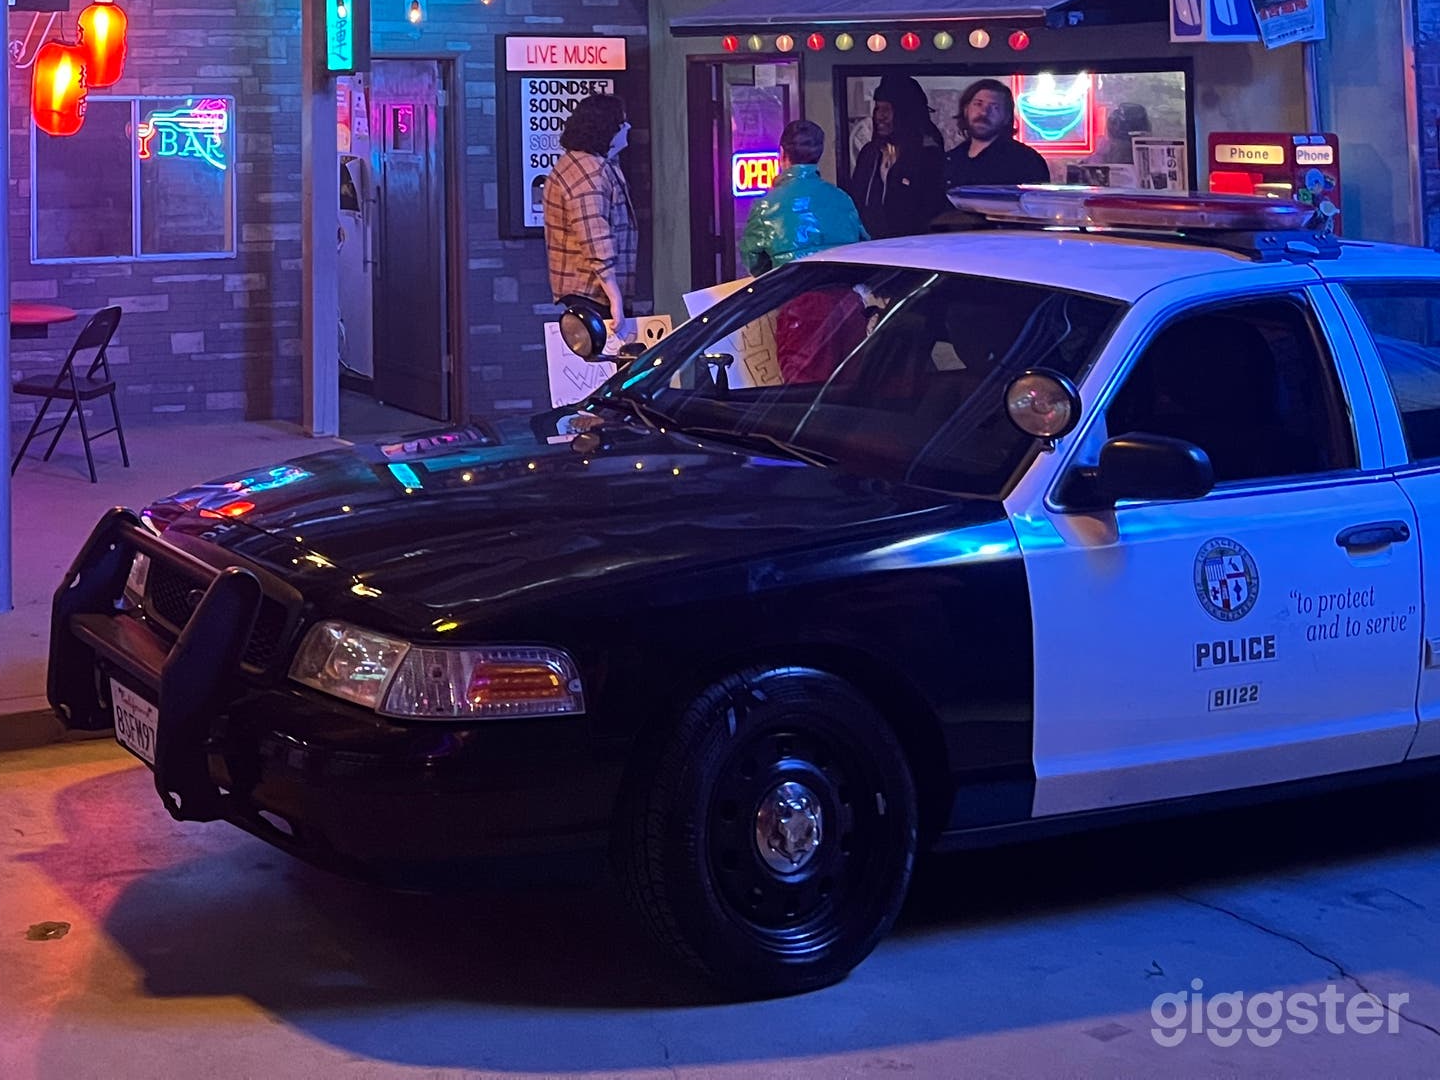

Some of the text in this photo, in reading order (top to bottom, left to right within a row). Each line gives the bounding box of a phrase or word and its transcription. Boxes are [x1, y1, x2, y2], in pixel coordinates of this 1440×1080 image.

[527, 45, 608, 64] LIVE MUSIC
[529, 80, 608, 95] SOUNDSET
[157, 127, 225, 158] BAR
[1230, 147, 1269, 160] Phone
[1297, 149, 1330, 162] Phone
[736, 159, 779, 190] OPEN
[1317, 586, 1375, 618] protect
[1306, 614, 1339, 642] and
[1346, 617, 1362, 638] to
[1196, 634, 1276, 668] POLICE
[1213, 684, 1259, 708] 81122
